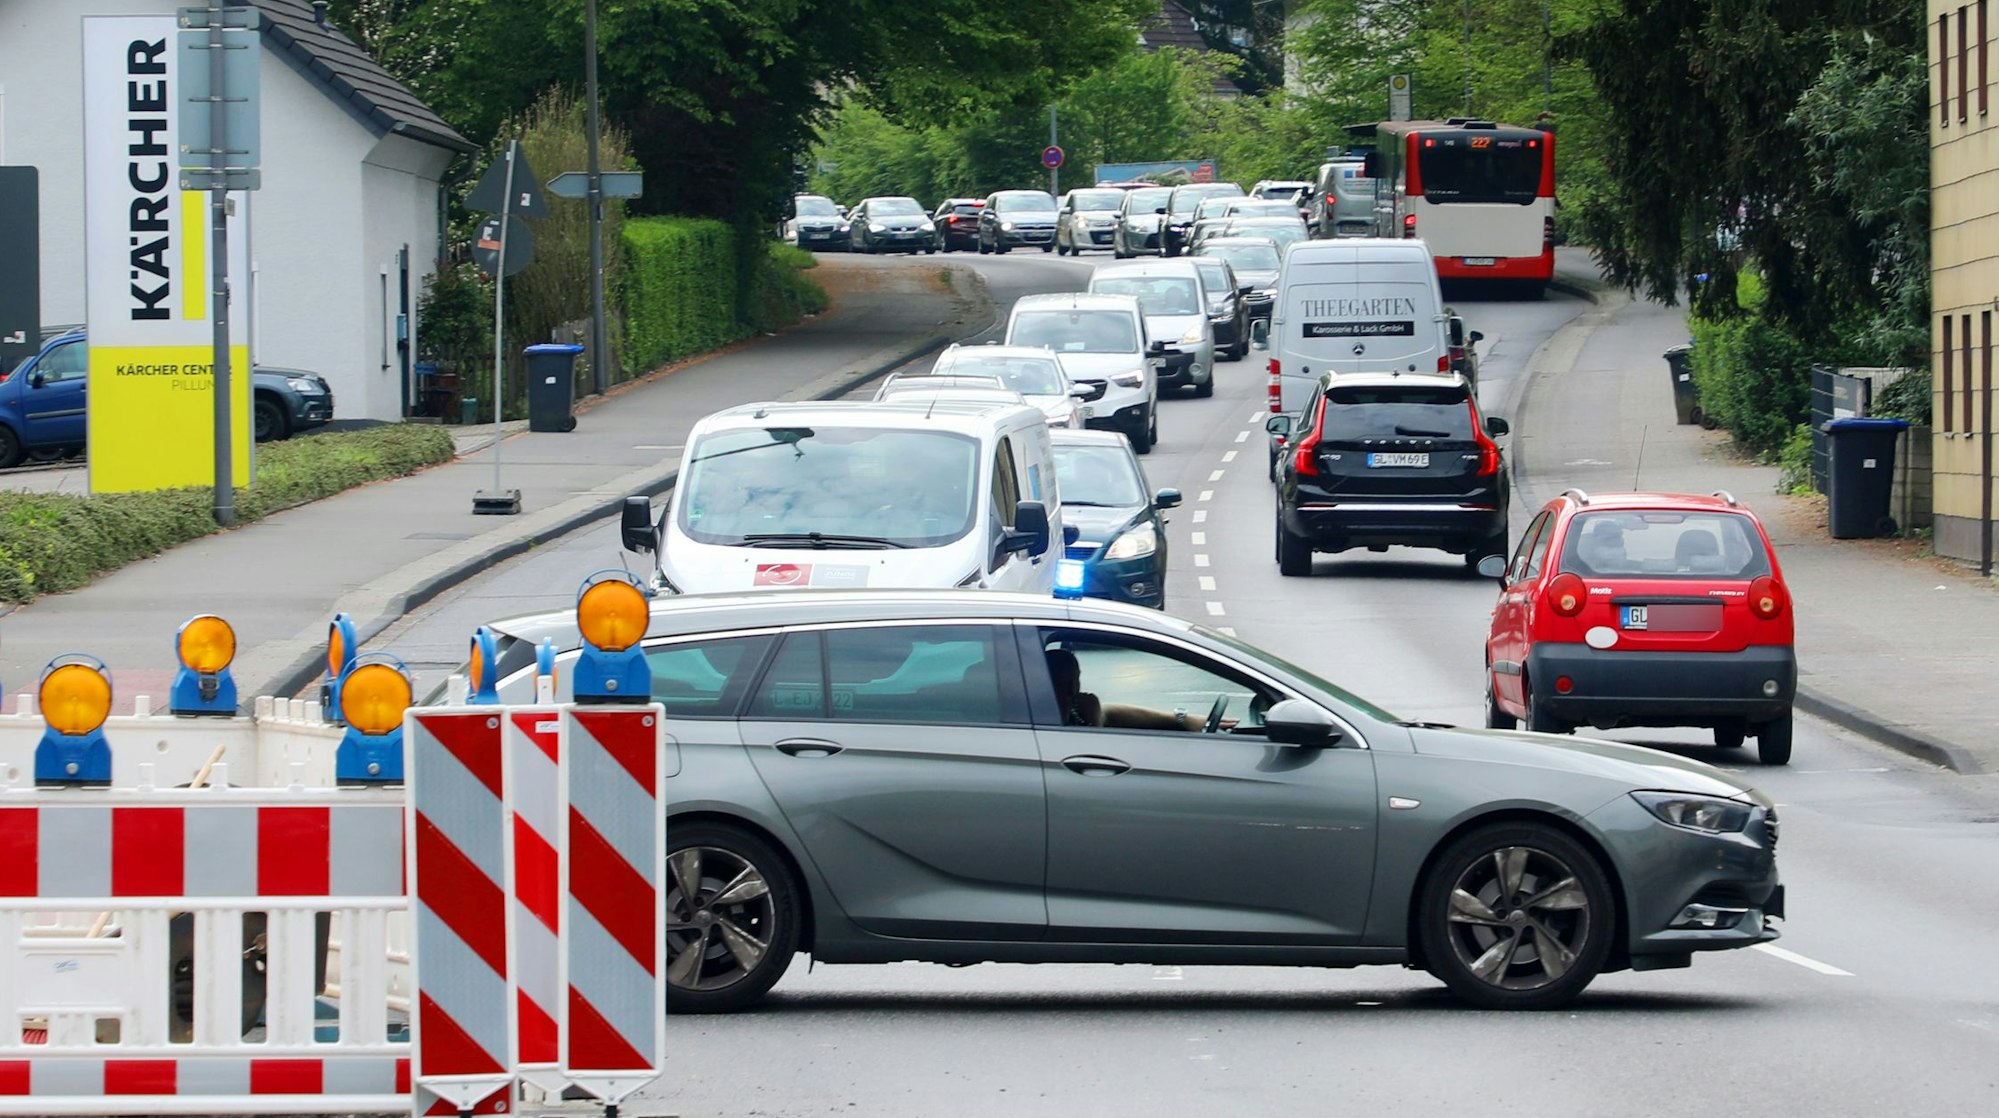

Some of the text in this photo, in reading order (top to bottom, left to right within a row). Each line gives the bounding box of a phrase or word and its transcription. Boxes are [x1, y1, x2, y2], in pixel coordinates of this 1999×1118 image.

[127, 37, 170, 320] KÄRCHER
[1301, 297, 1416, 317] THEEGARTEN
[1312, 325, 1352, 334] Karosserie
[1361, 325, 1378, 333] Lack
[1379, 324, 1405, 332] GmbH
[116, 363, 232, 376] KÄRCHER CENT
[1631, 608, 1647, 623] GL
